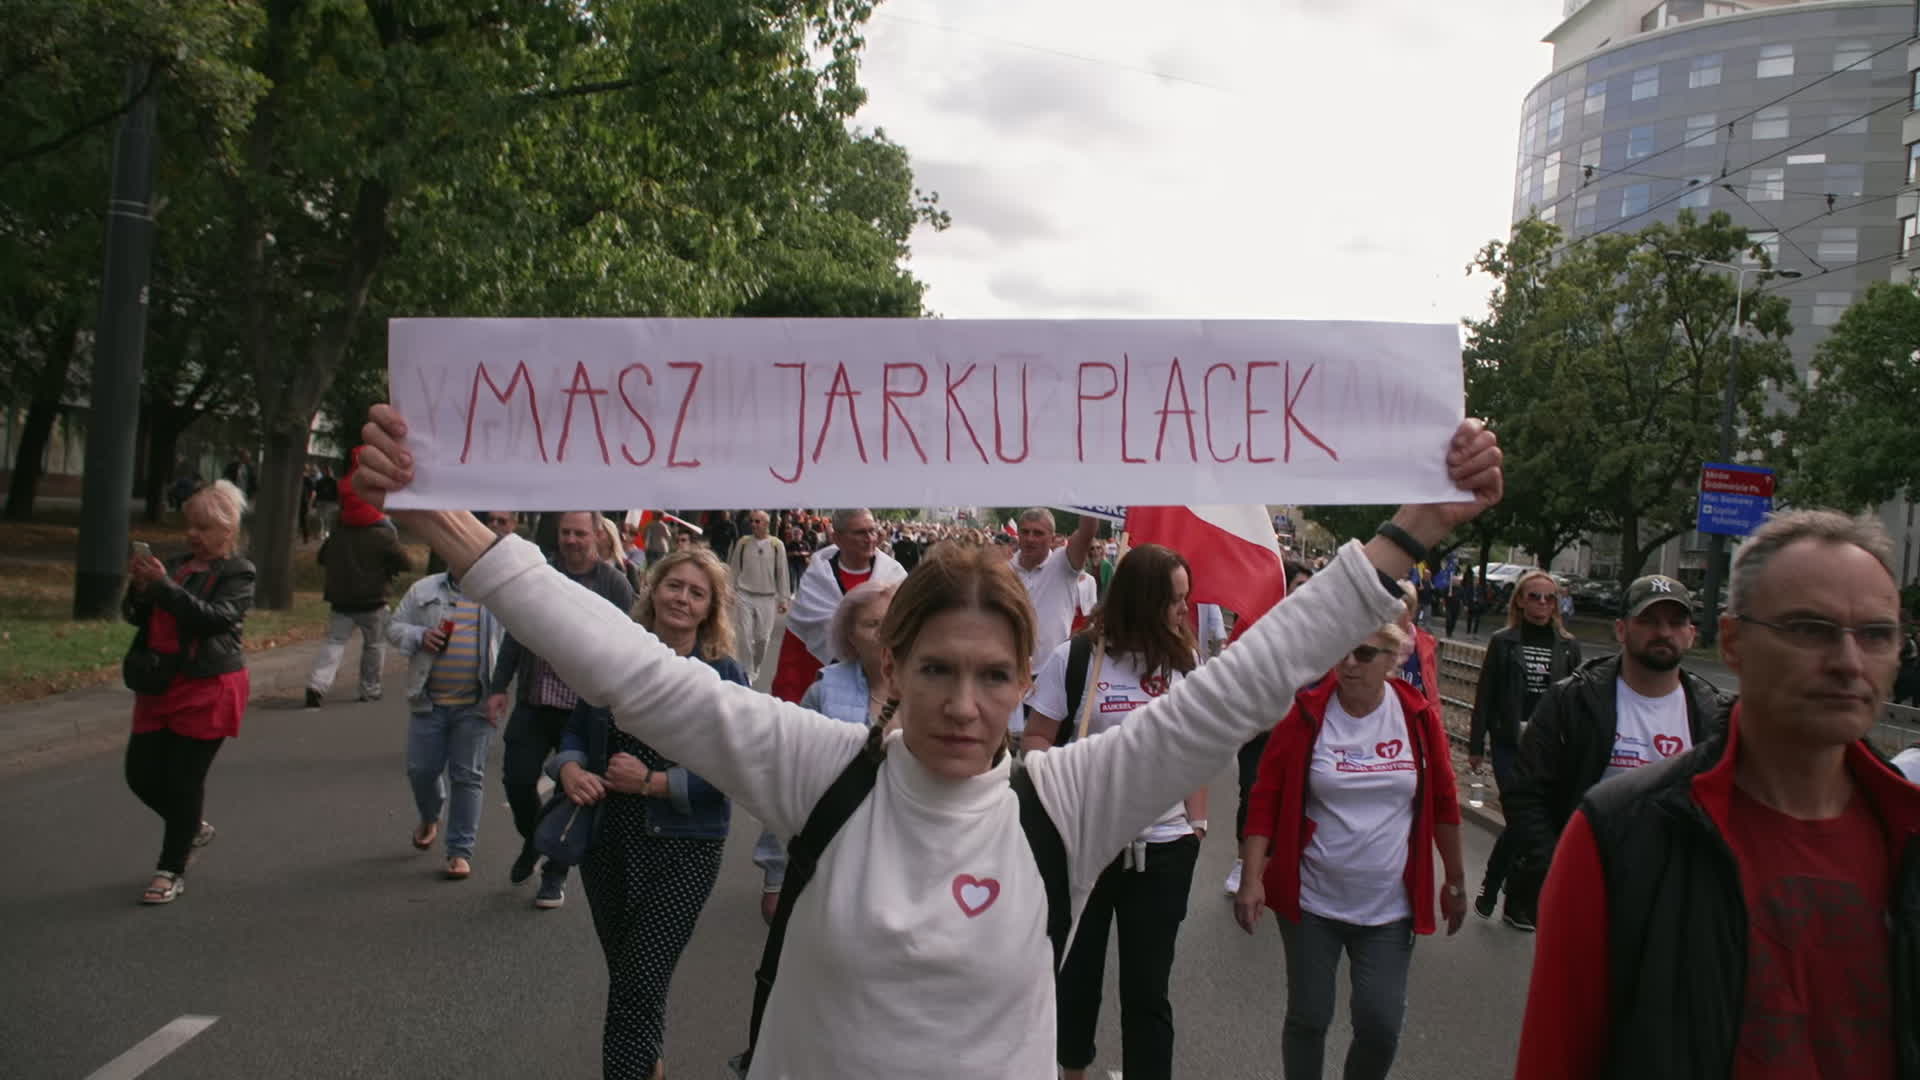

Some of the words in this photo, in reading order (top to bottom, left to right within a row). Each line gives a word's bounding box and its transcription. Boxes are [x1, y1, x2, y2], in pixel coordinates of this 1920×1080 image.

[459, 360, 705, 468] MASZ
[767, 360, 1029, 484] JARKU
[1076, 352, 1340, 465] PLACEK
[1651, 578, 1671, 592] NY
[1381, 743, 1399, 757] 17
[1659, 740, 1681, 754] 17
